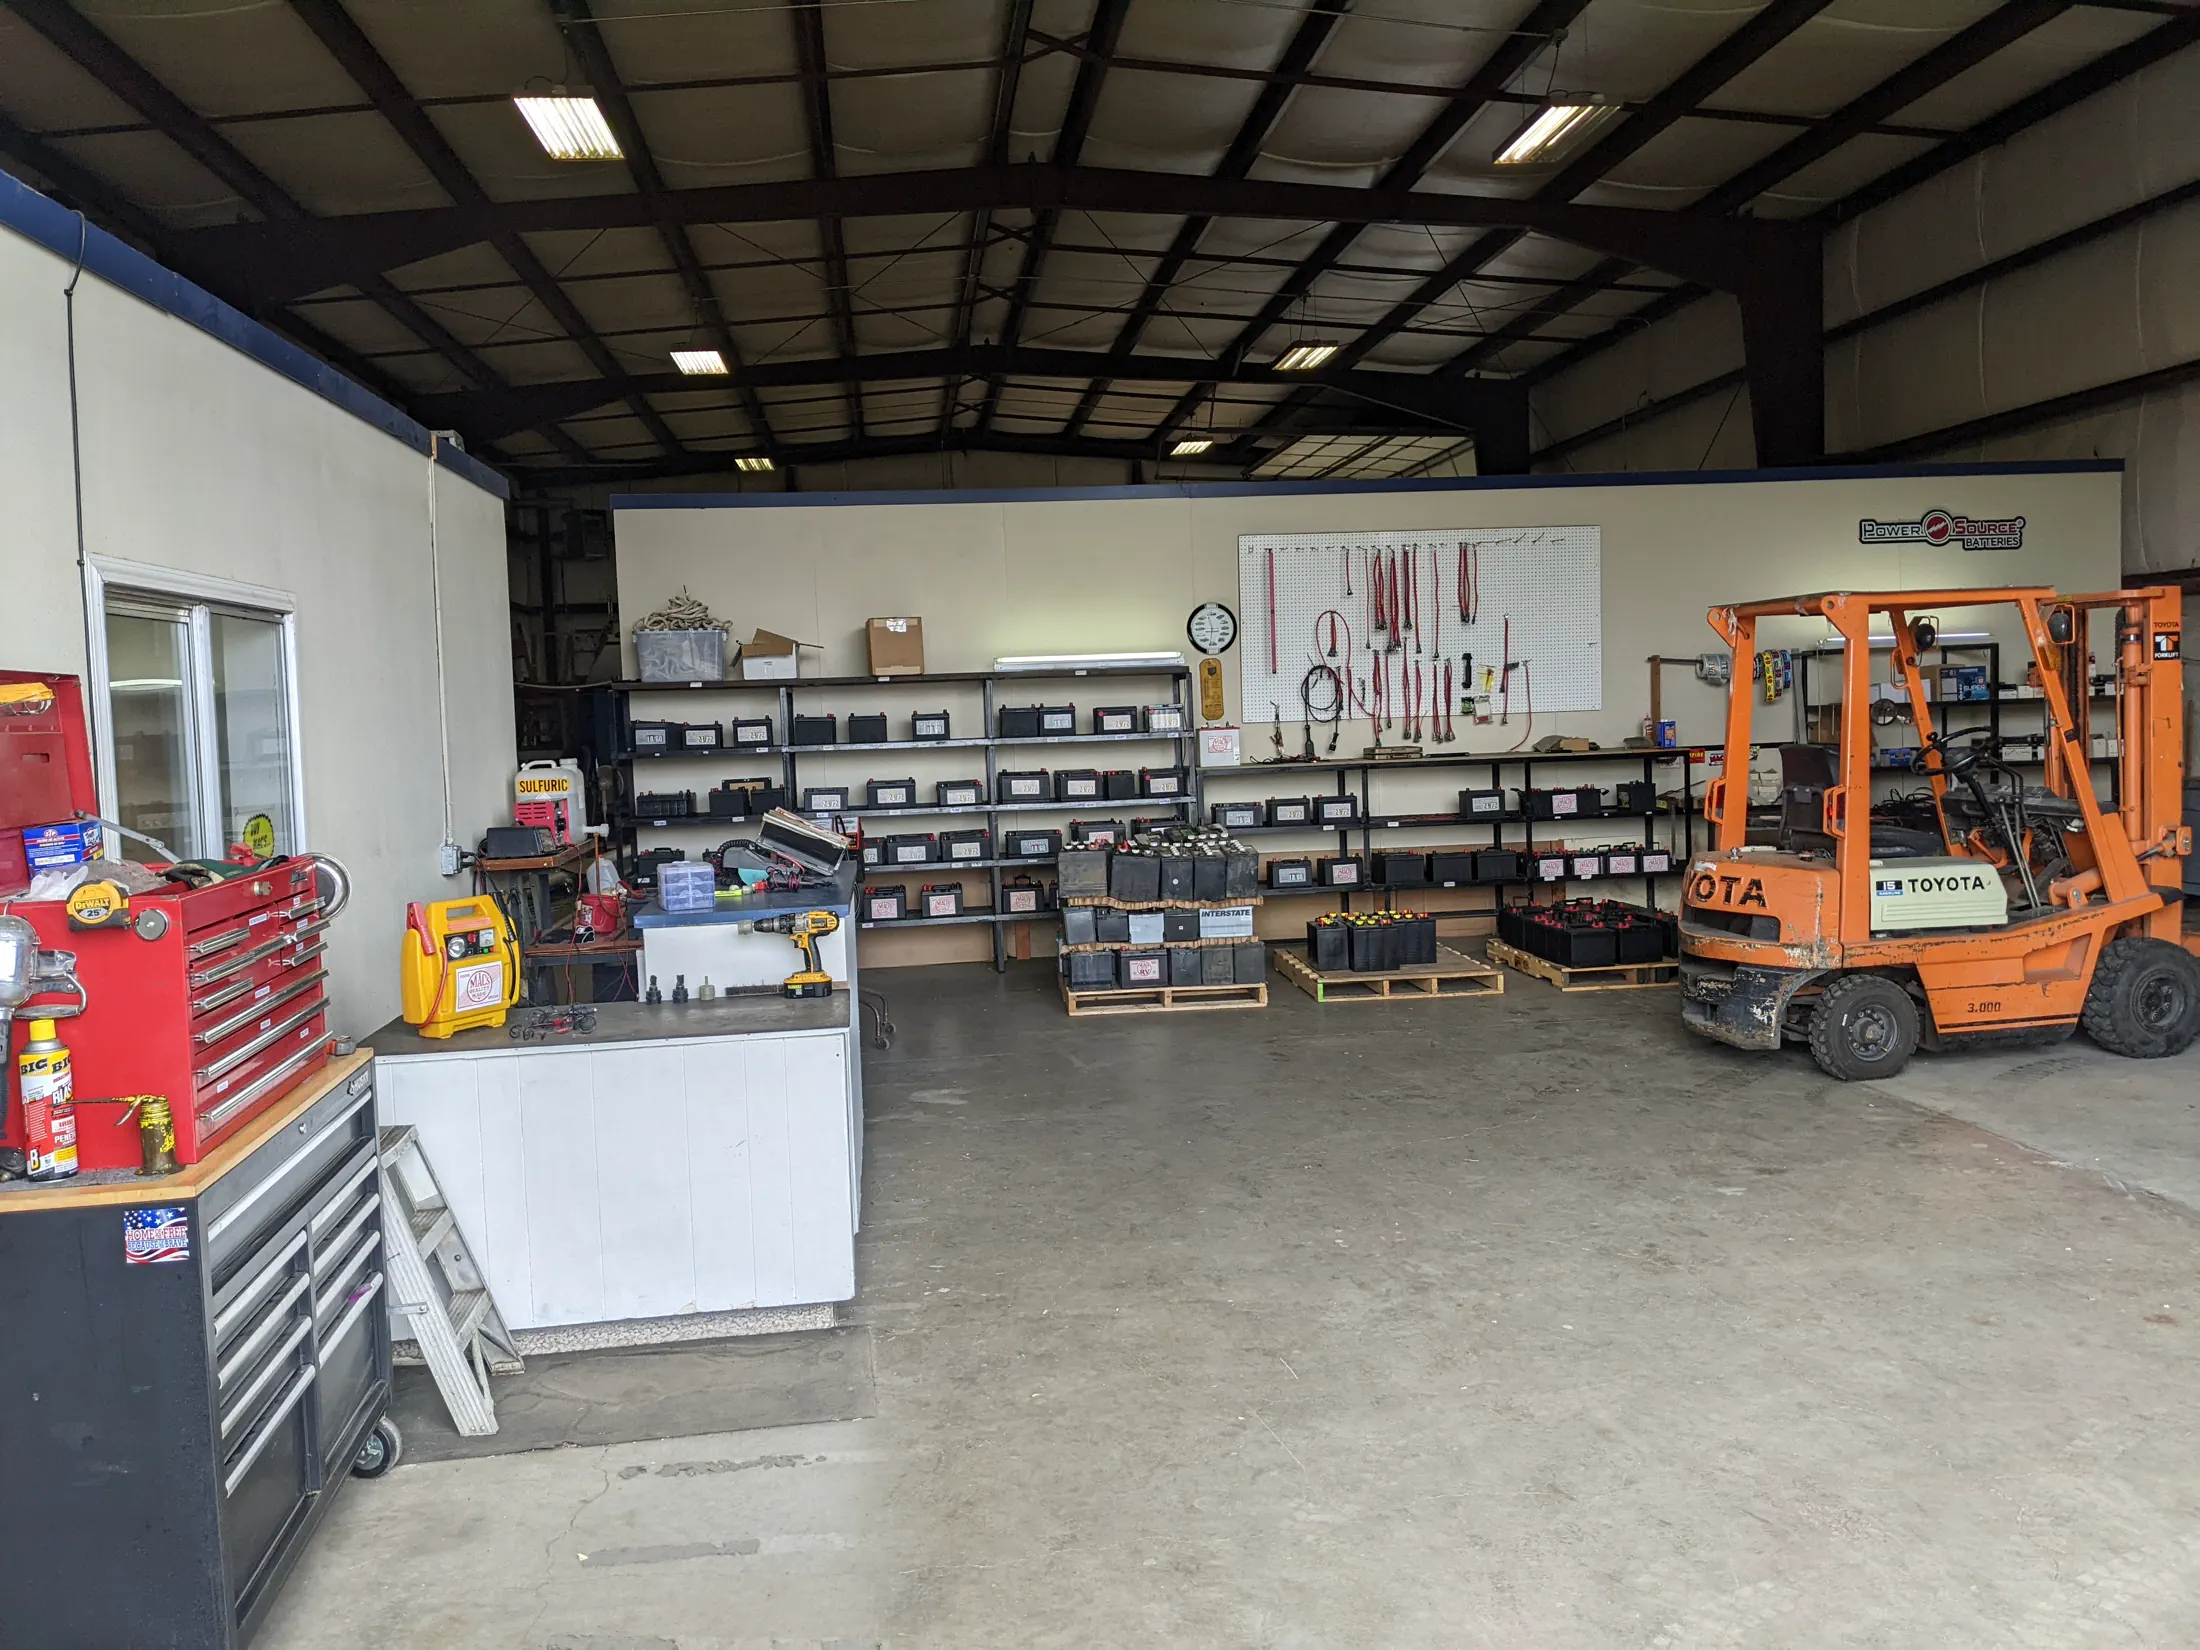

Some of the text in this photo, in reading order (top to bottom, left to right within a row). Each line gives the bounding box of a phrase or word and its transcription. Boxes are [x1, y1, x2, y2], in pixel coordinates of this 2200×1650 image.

[1863, 519, 2018, 537] POWER SOURCE
[1965, 536, 2020, 548] BATTERIES
[519, 779, 569, 793] SULFURIC
[1883, 881, 1896, 890] 15
[1907, 875, 1985, 893] TOYOTA
[1201, 909, 1251, 918] INTERSTATE
[1967, 1001, 2001, 1013] 3.000
[20, 1057, 48, 1075] BIG
[127, 1229, 155, 1241] HOME
[163, 1226, 186, 1239] FREE
[127, 1239, 159, 1251] BECAUSE
[164, 1238, 188, 1249] BRAVE
